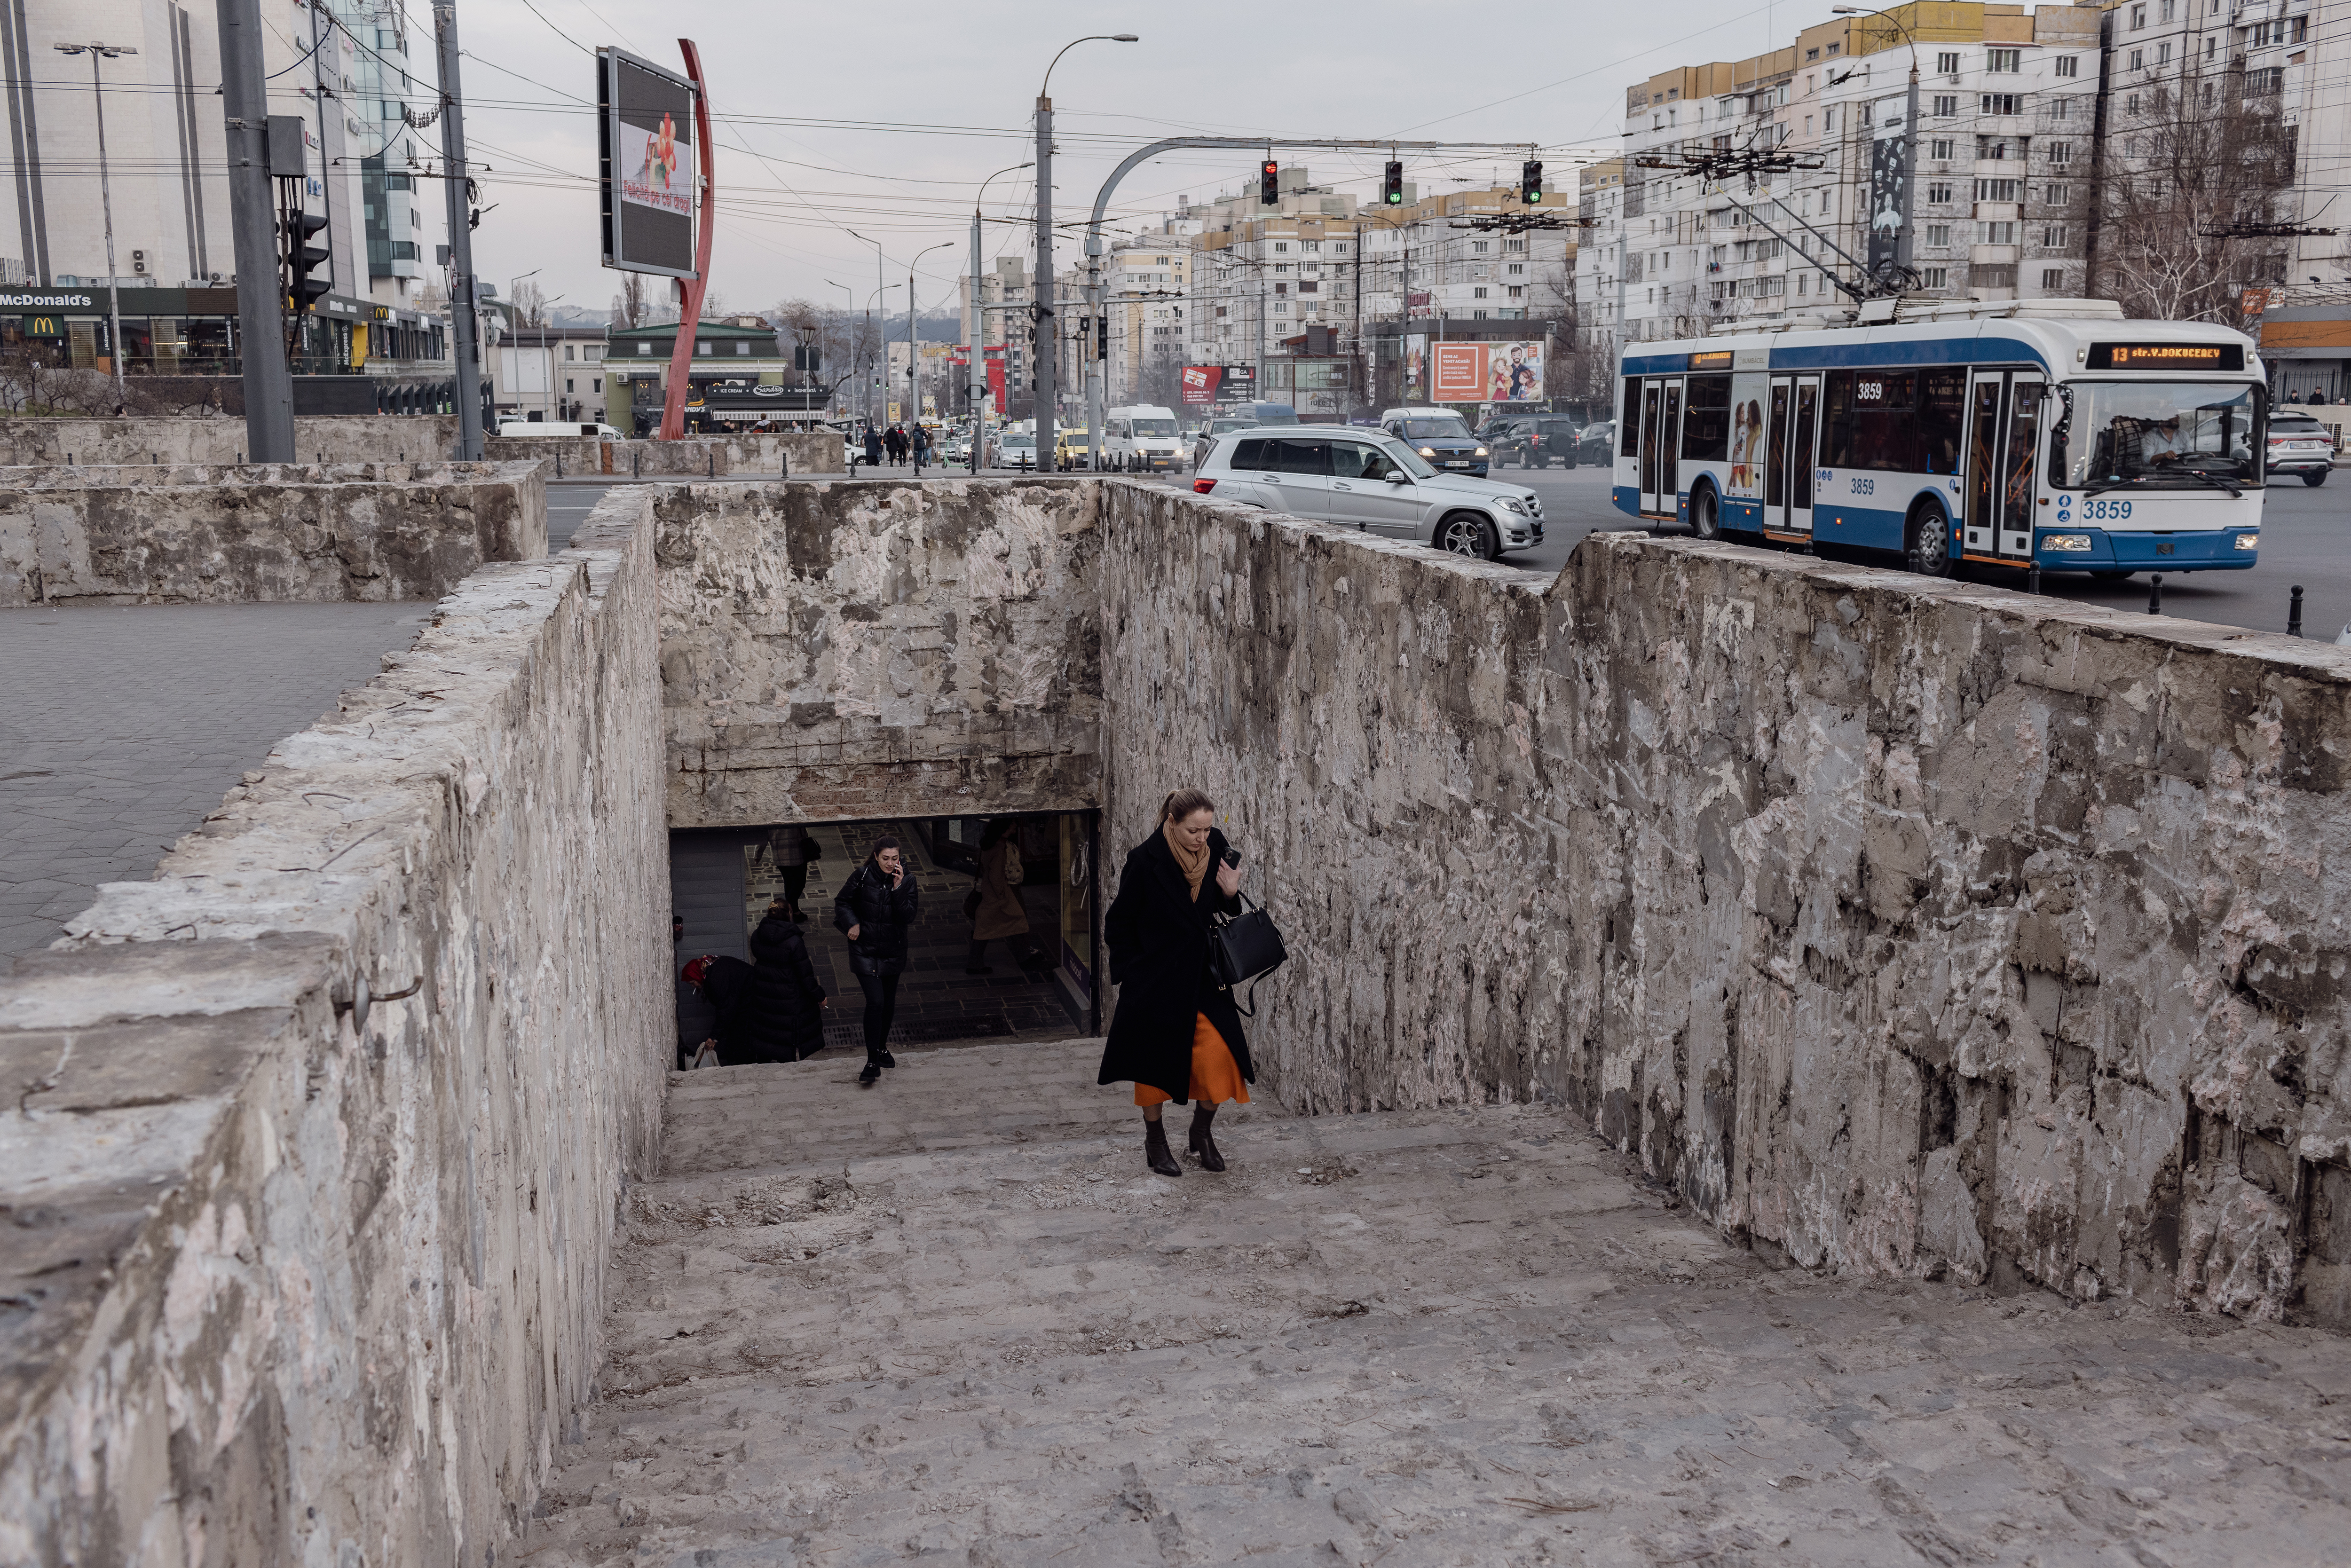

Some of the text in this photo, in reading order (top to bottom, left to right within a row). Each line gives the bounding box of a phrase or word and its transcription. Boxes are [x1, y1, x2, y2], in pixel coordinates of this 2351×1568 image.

[0, 294, 91, 306] McDonald's
[2113, 348, 2128, 361] 13
[755, 385, 782, 393] Sandra
[1858, 383, 1882, 400] 3859
[1851, 478, 1874, 495] 3859
[2083, 501, 2132, 520] 3859
